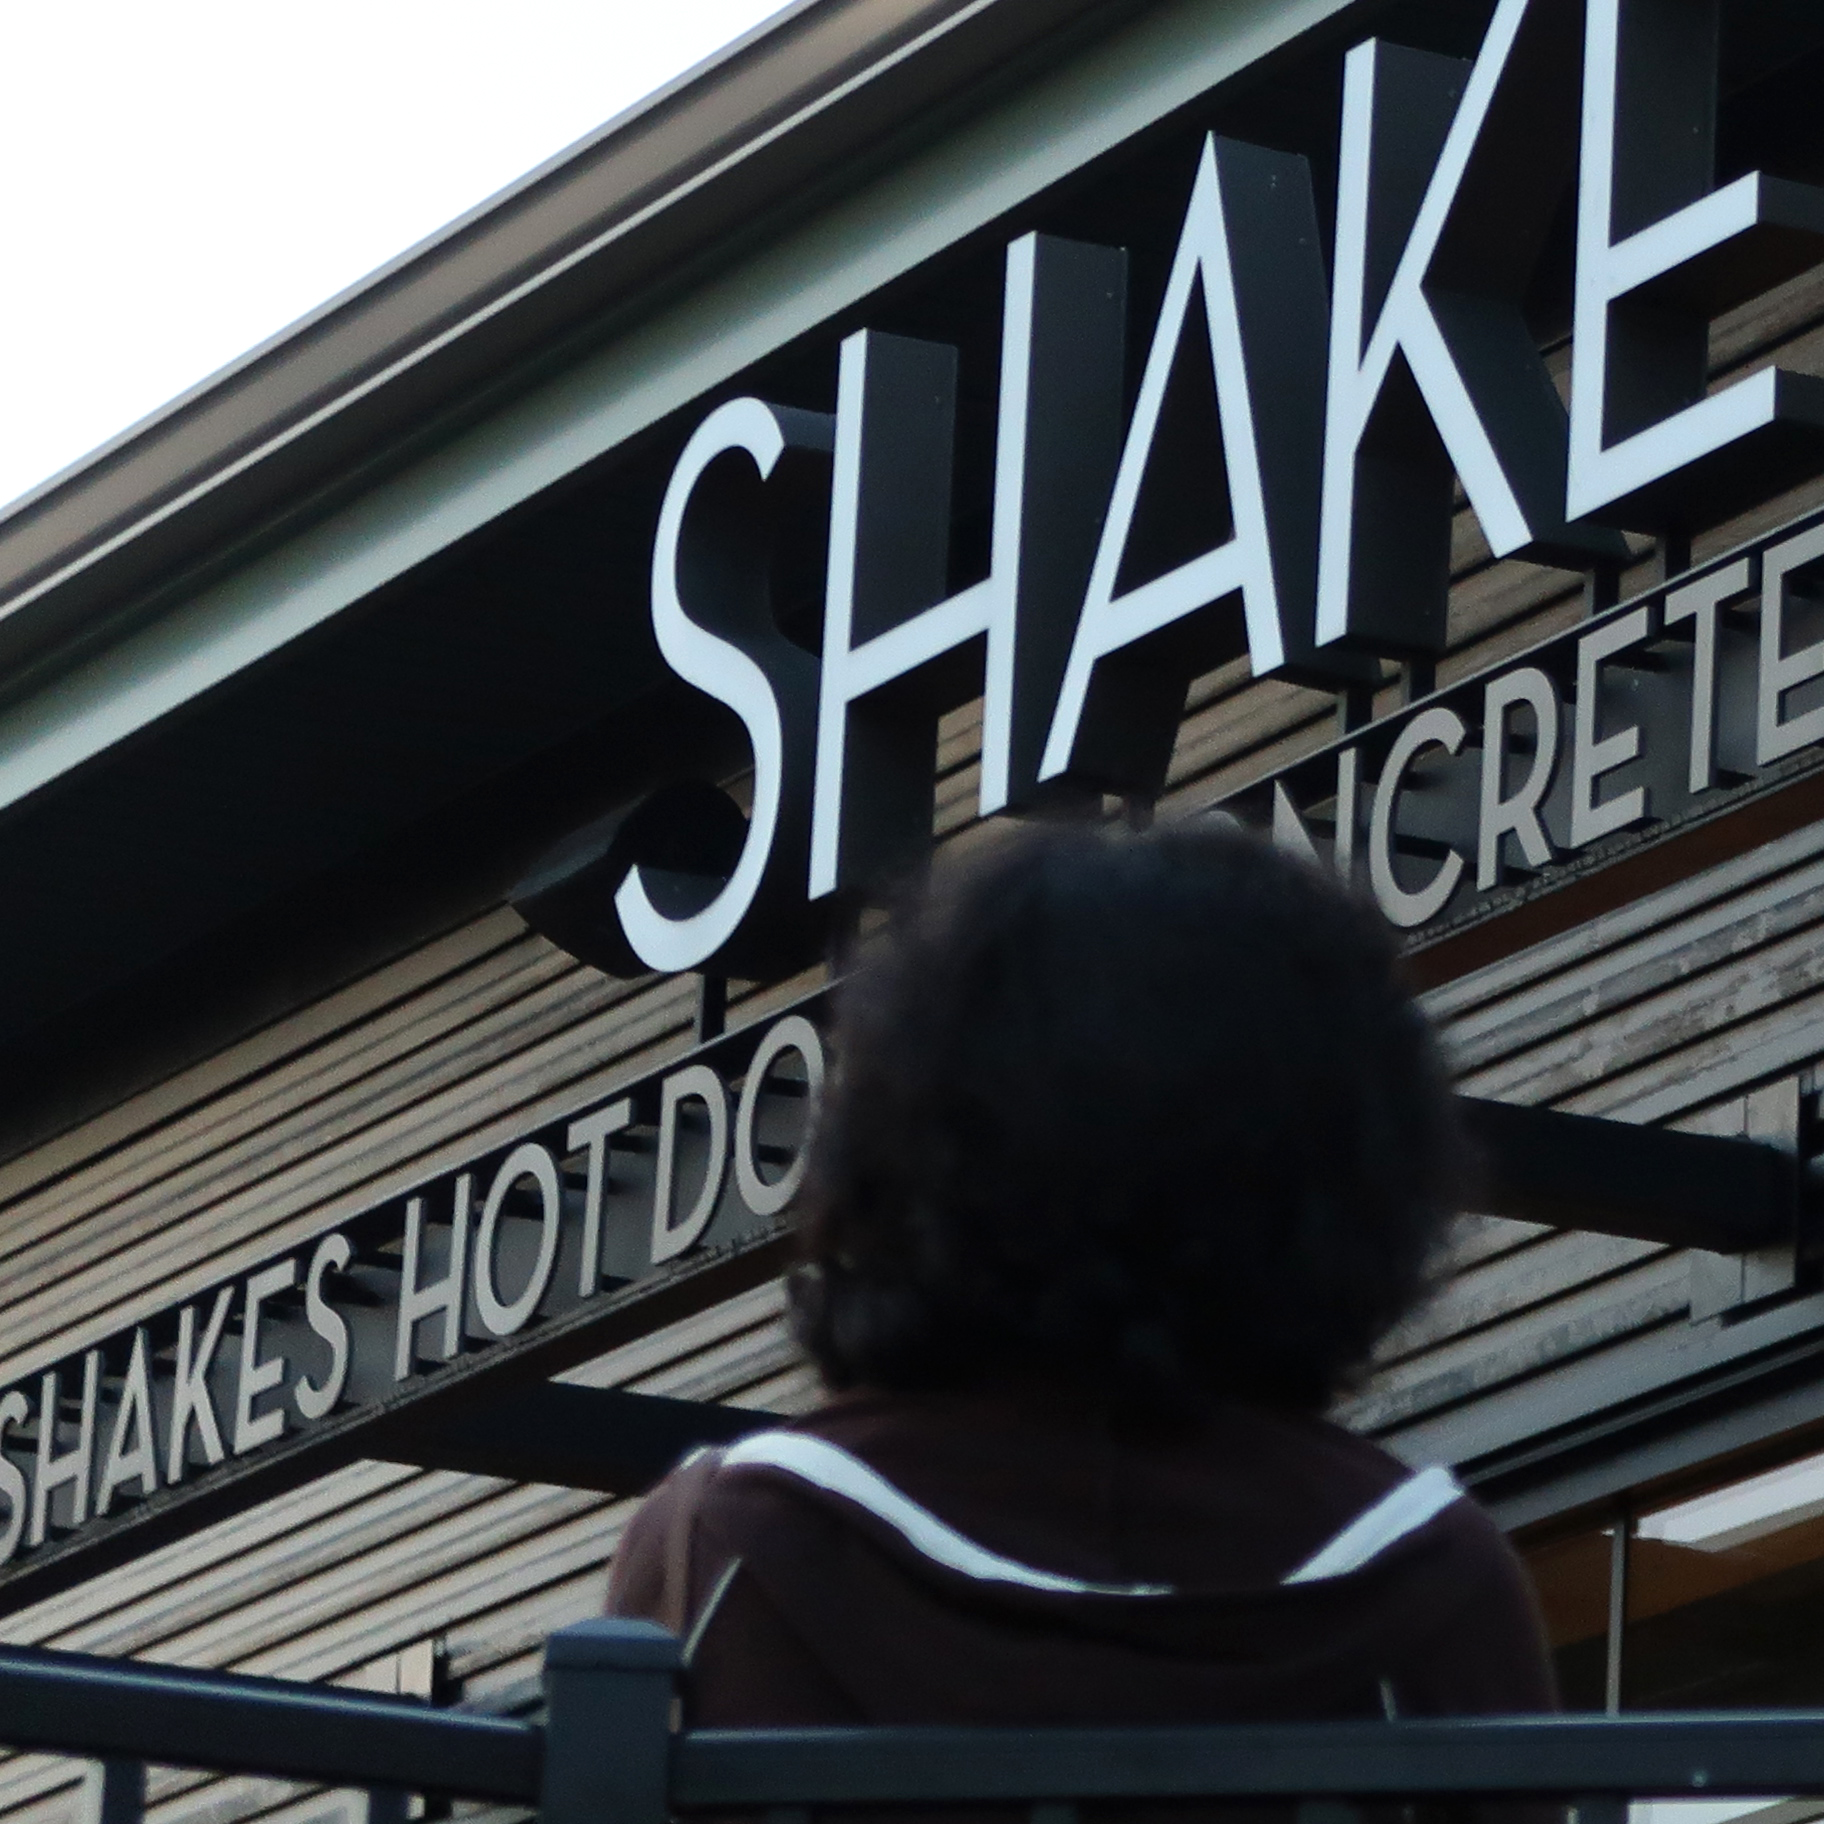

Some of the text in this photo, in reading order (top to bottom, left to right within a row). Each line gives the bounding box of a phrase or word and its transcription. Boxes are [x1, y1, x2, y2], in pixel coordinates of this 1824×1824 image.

[0, 1233, 353, 1565] SHAKES
[395, 1097, 639, 1382] HOT
[650, 1015, 825, 1265] DO
